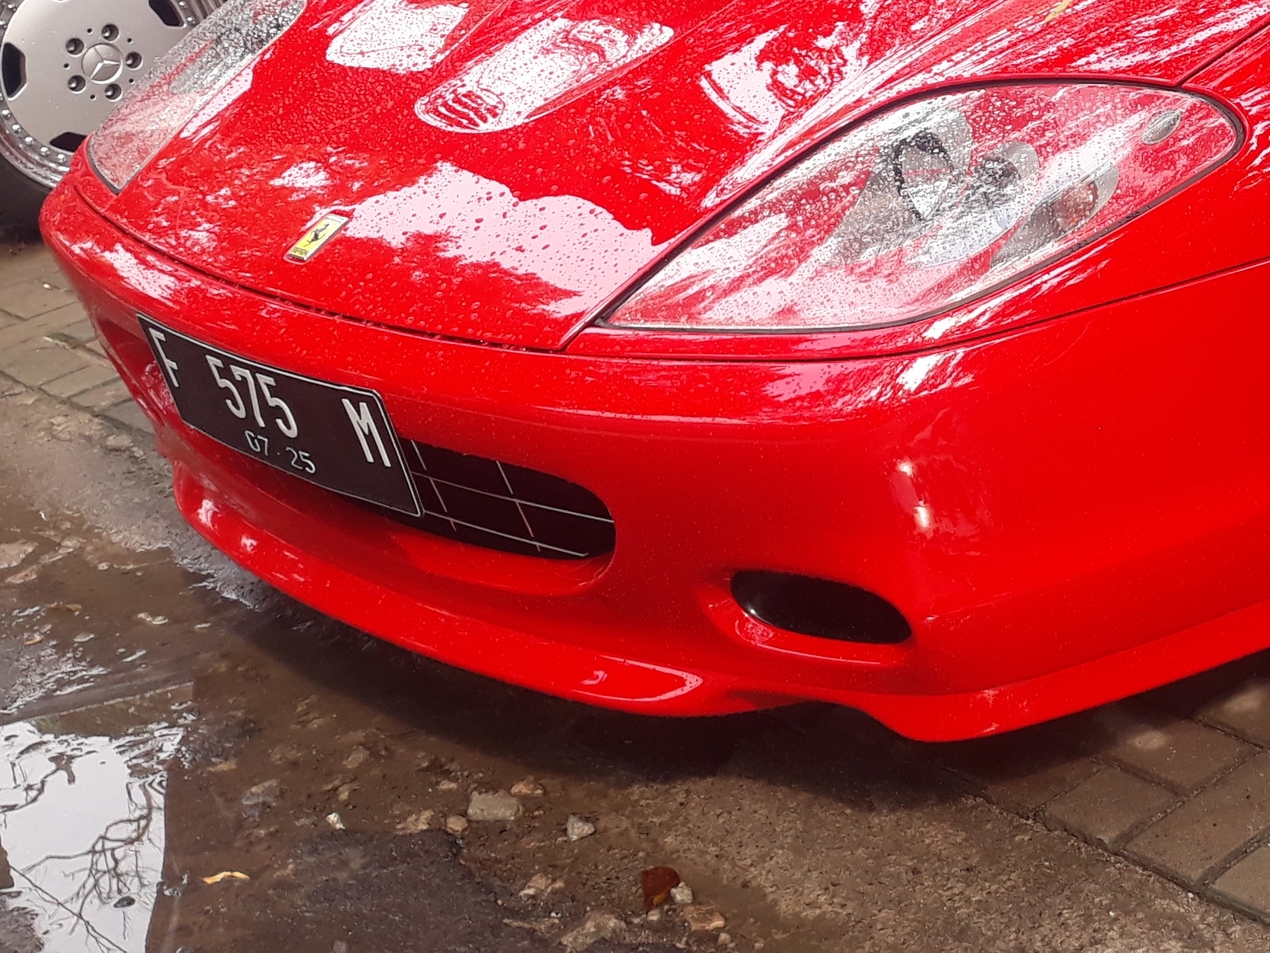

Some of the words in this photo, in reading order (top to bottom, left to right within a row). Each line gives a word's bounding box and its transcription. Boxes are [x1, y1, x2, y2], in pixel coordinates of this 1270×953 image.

[148, 327, 179, 387] F
[205, 354, 298, 438] 575
[341, 398, 392, 468] M
[286, 447, 316, 474] 25
